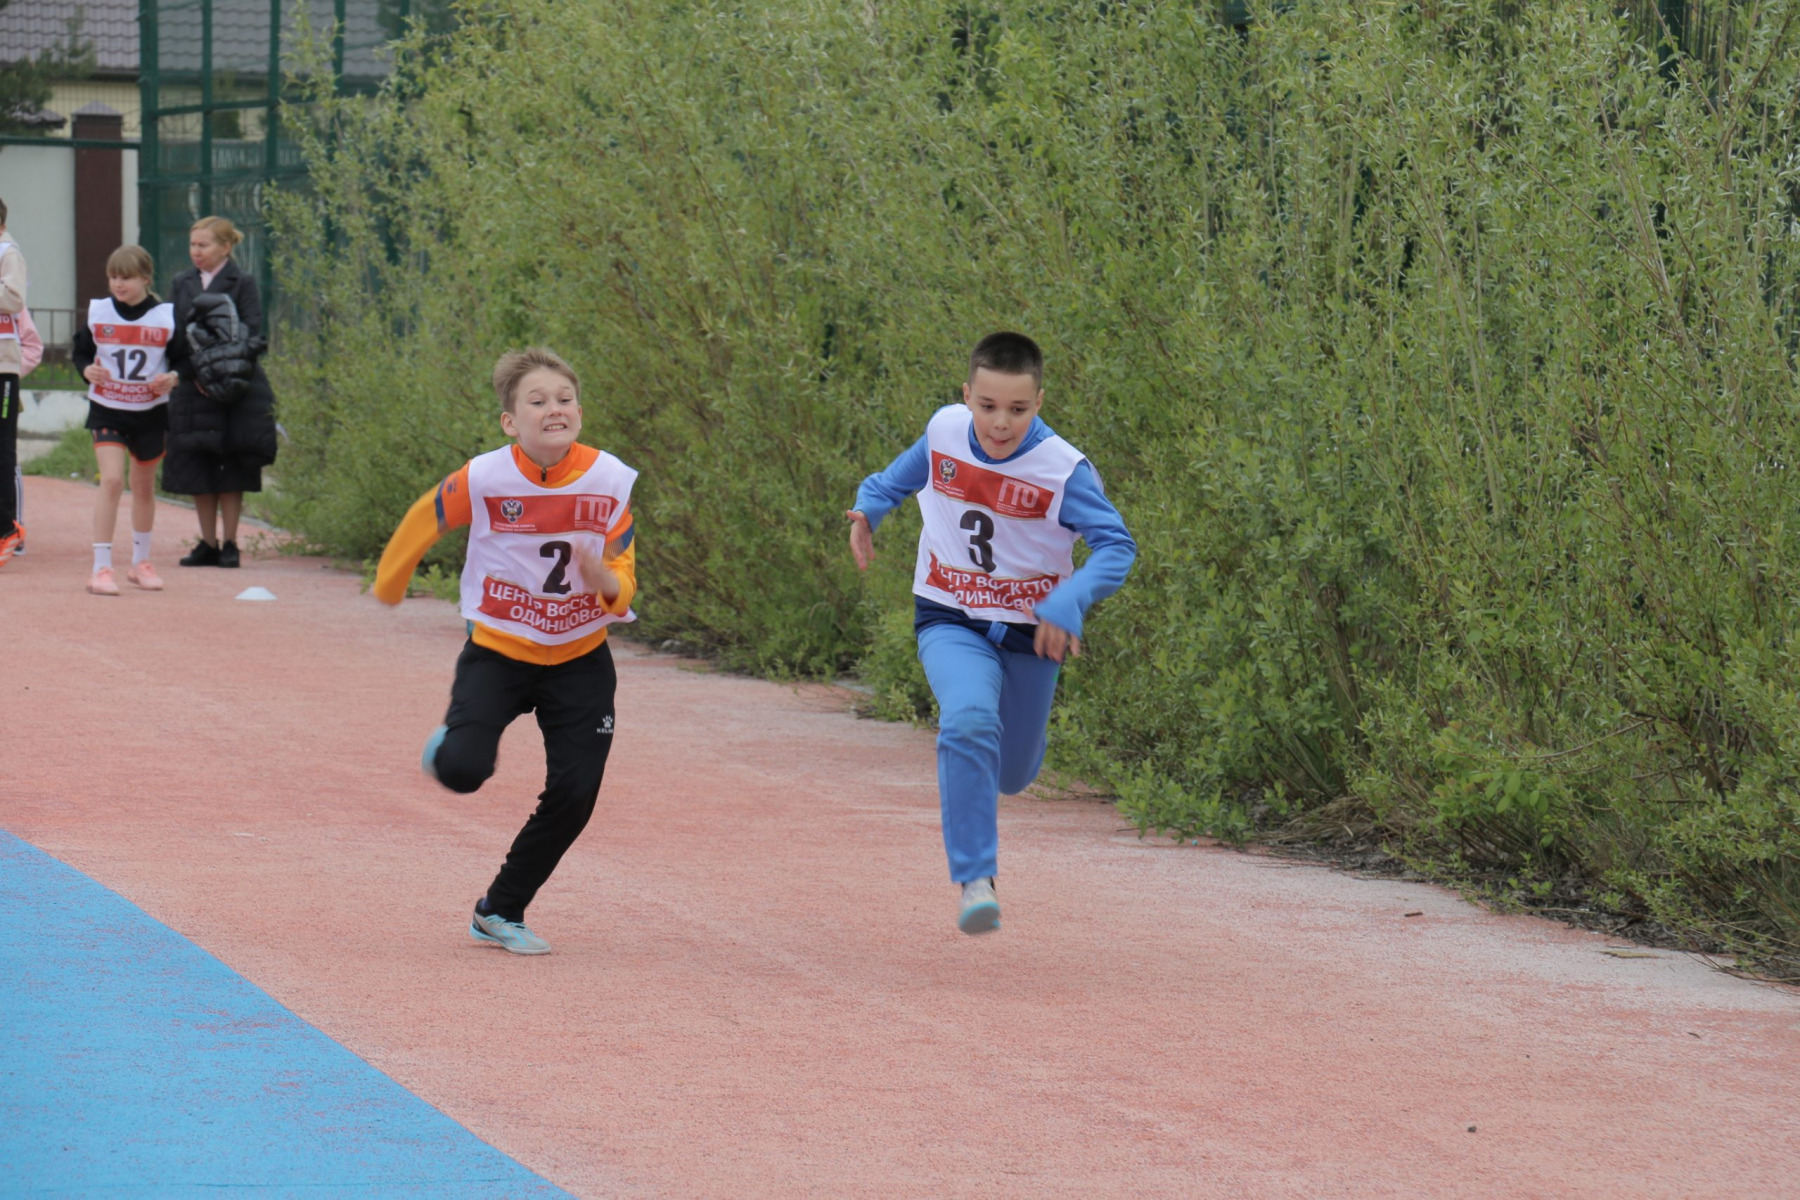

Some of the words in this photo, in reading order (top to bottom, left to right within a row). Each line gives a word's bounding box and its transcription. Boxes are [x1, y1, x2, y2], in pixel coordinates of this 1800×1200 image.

[111, 349, 147, 381] 12
[998, 477, 1040, 509] ГТО
[574, 495, 612, 524] ГТО
[959, 510, 997, 574] 3
[539, 540, 572, 595] 2
[948, 585, 1036, 611] ДИНЦОВО
[509, 604, 602, 632] ОДИНЦОВО
